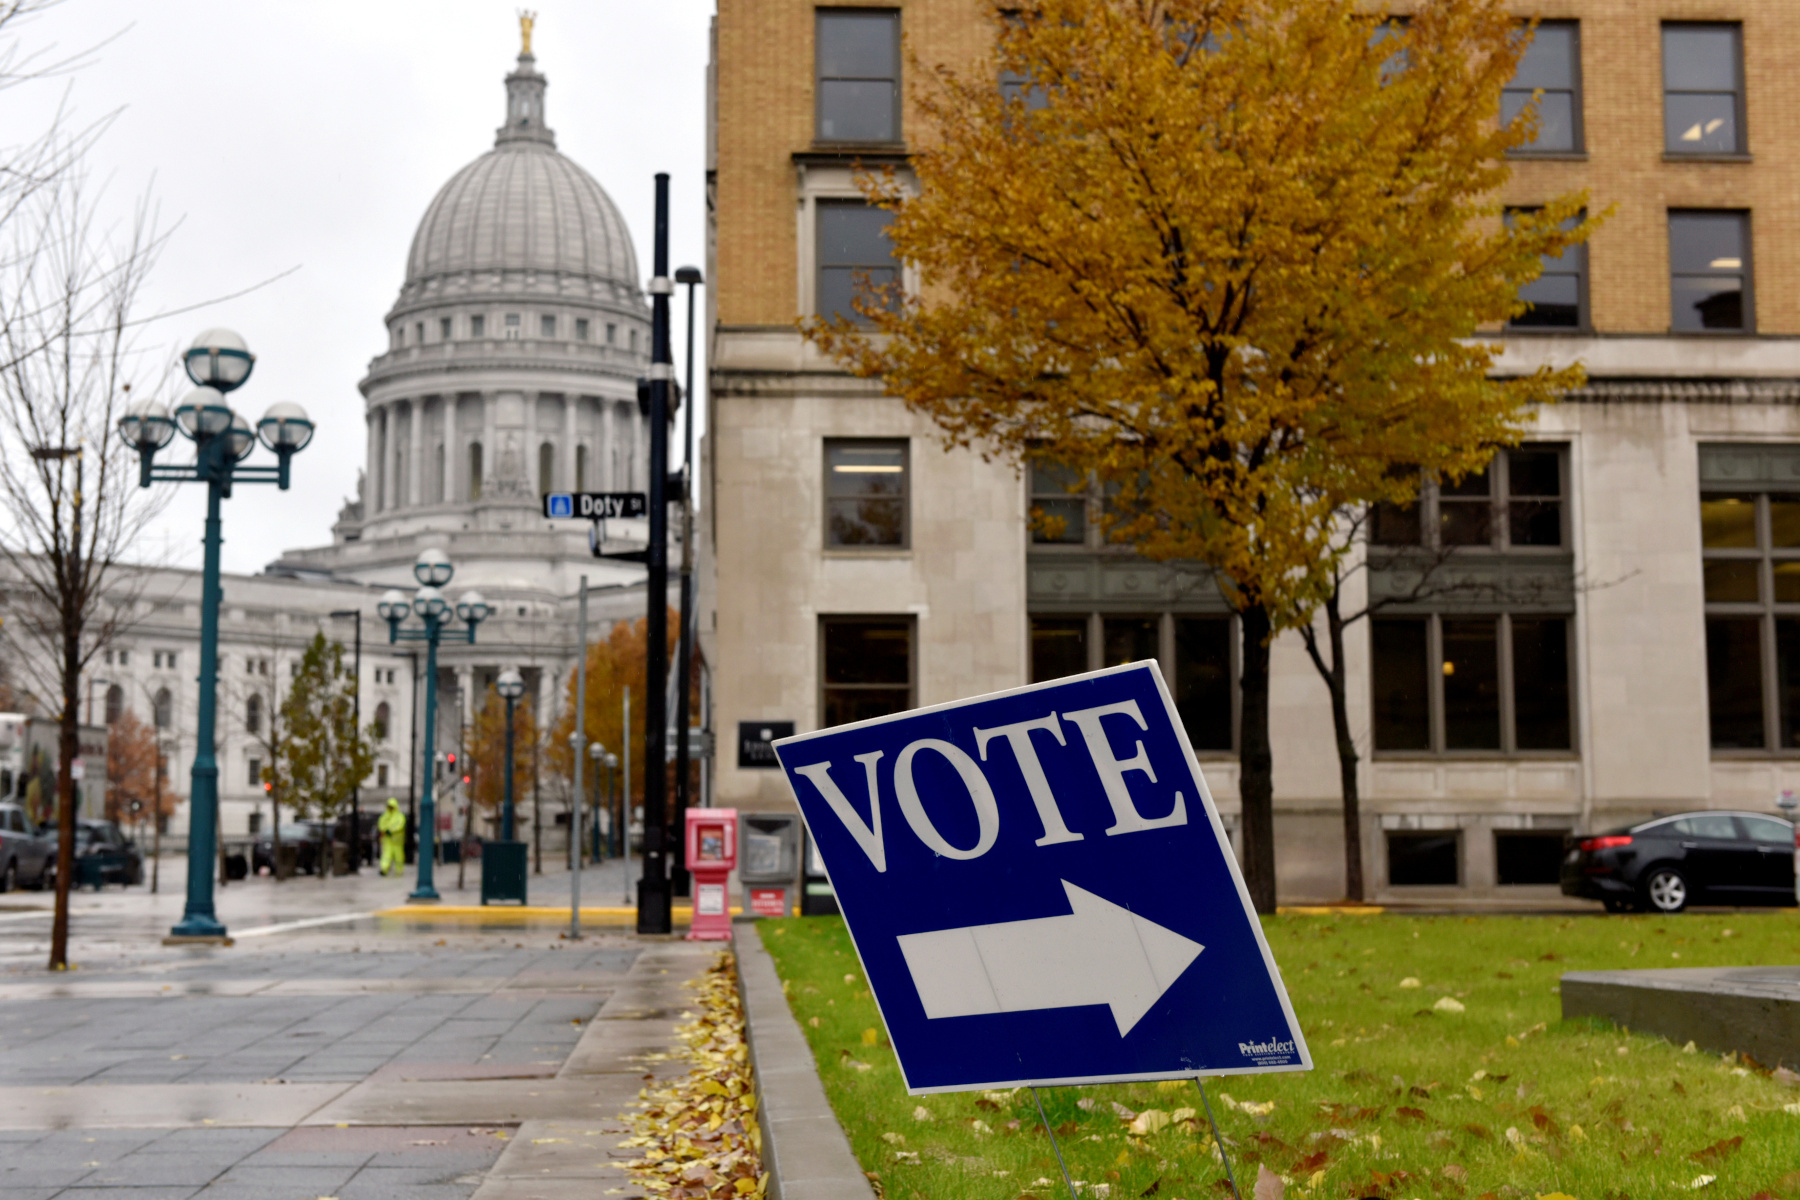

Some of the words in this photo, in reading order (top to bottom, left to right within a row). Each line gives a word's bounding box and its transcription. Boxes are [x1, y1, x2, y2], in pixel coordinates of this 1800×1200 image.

[580, 494, 624, 518] Doty
[794, 699, 1188, 874] VOTE
[1238, 1036, 1295, 1055] Printelect
